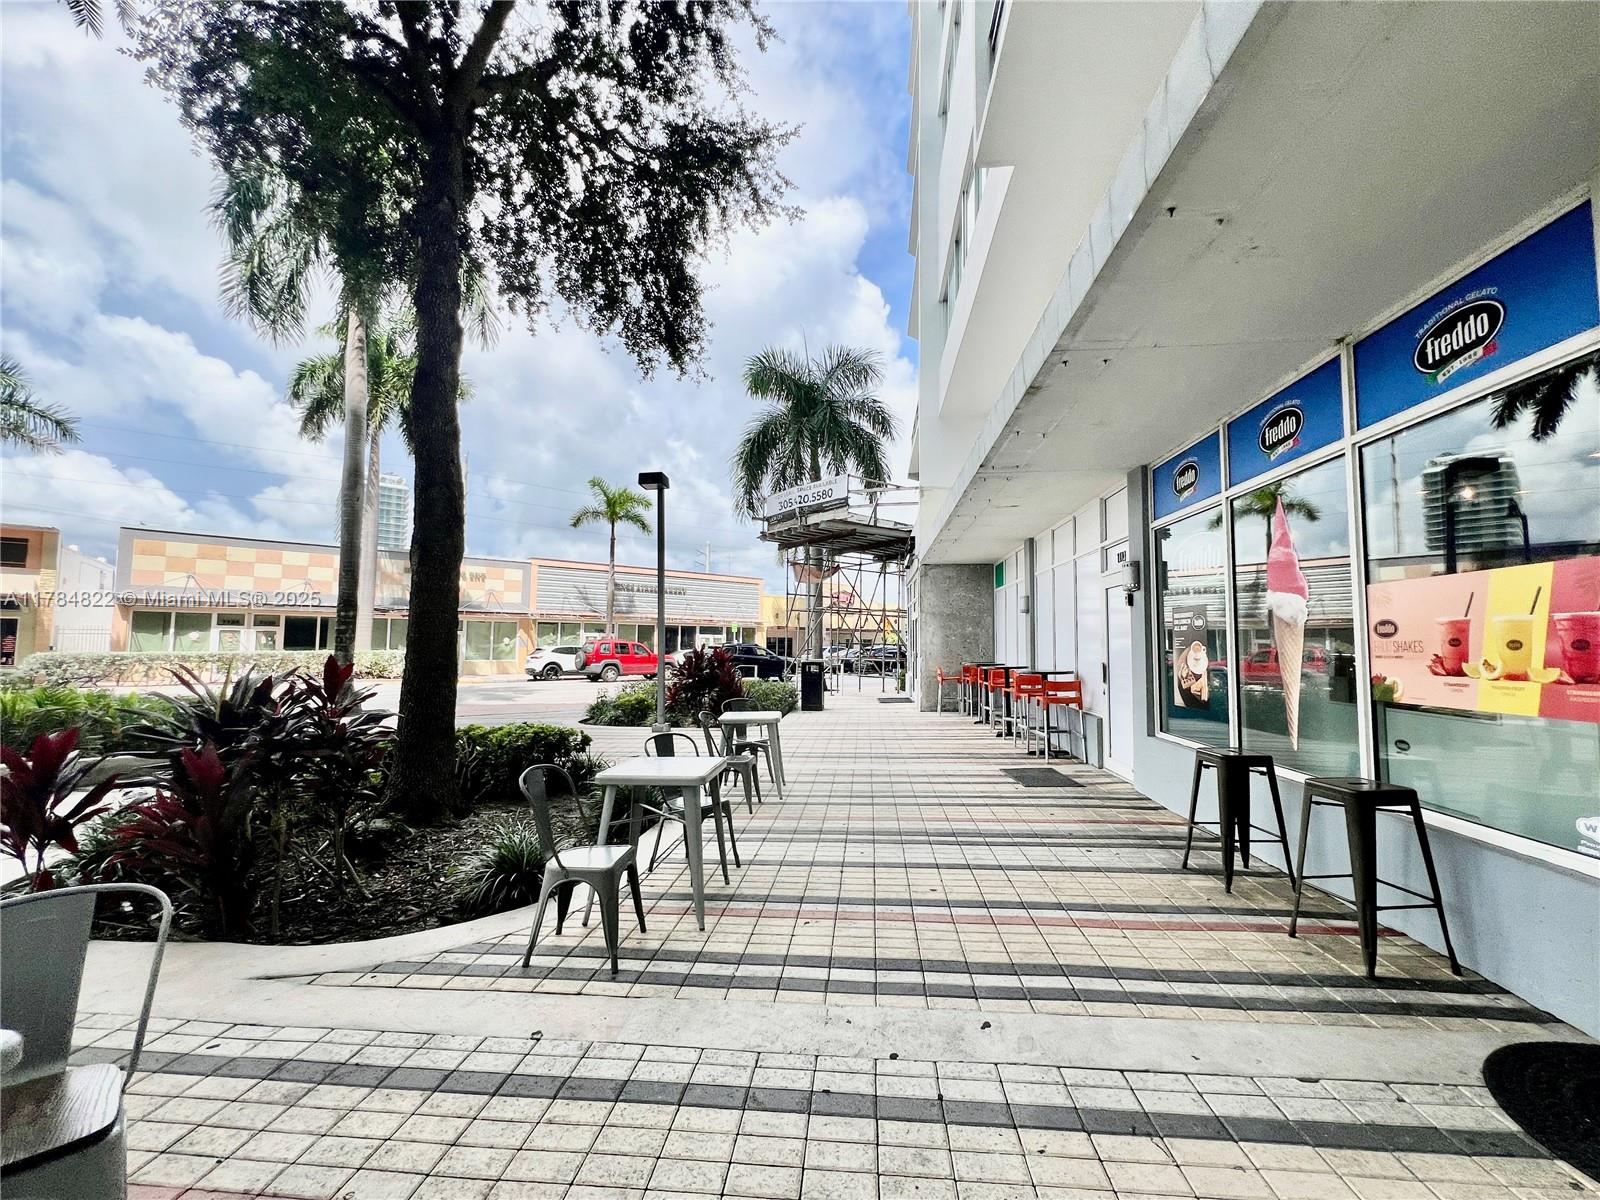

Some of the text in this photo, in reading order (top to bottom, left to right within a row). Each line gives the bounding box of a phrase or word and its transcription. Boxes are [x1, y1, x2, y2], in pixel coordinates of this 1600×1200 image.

[1425, 312, 1490, 365] freddo
[1264, 415, 1296, 447] freddo
[1392, 640, 1425, 654] SHAKES
